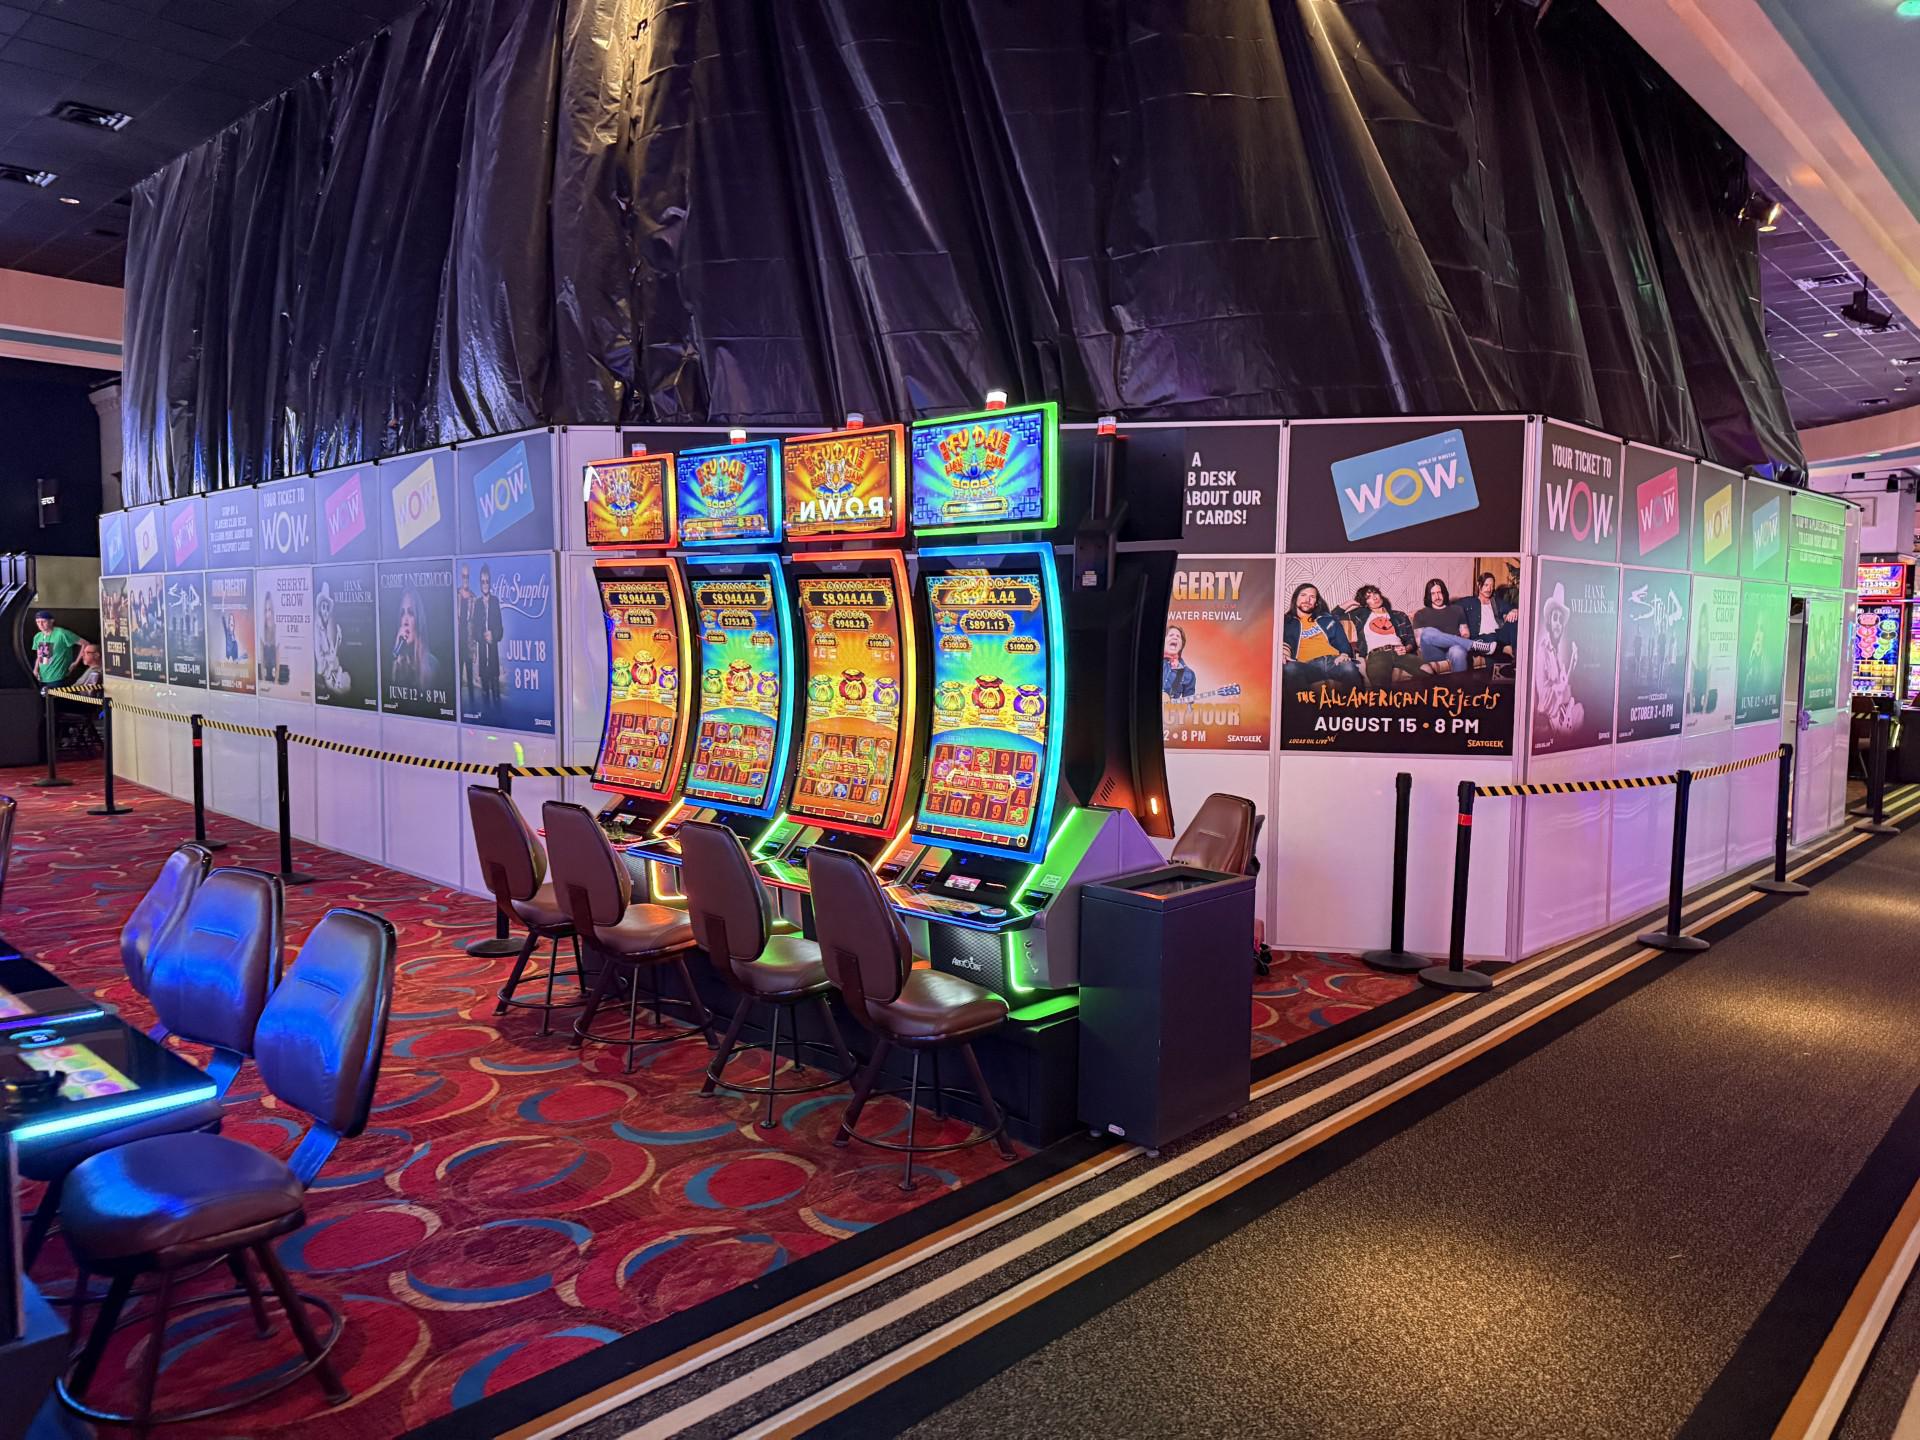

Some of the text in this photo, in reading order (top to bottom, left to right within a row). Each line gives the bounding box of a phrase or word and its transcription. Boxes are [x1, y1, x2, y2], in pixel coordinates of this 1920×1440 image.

[1191, 452, 1202, 467] A
[1551, 444, 1612, 479] YOUR TICKET TO
[1200, 470, 1237, 486] DESK
[263, 488, 304, 508] YOUR TICKET TO
[1233, 490, 1261, 506] OUR
[1196, 509, 1247, 525] CARDS!
[276, 577, 308, 592] SHERYL
[404, 571, 453, 588] UNDERWOOD
[511, 572, 549, 611] Supply
[280, 593, 304, 607] CROW
[275, 614, 304, 624] SEPTEMBER
[1202, 611, 1242, 621] REVIVAL
[969, 620, 1005, 630] $891.15
[506, 639, 546, 662] JULY 18
[514, 668, 539, 690] 8 PM
[389, 685, 447, 704] JUNE 12 8 PM
[1296, 691, 1316, 704] THE
[1190, 703, 1241, 726] TOUR
[1630, 705, 1654, 721] OCTOBER
[1666, 704, 1674, 717] PM
[1314, 716, 1479, 734] AUGUST 15 8 PM
[1181, 730, 1188, 741] 8
[1191, 730, 1207, 742] PM
[1227, 734, 1262, 744] SEATGEEK
[1467, 738, 1504, 749] SEATGEEK
[1020, 755, 1032, 770] 10
